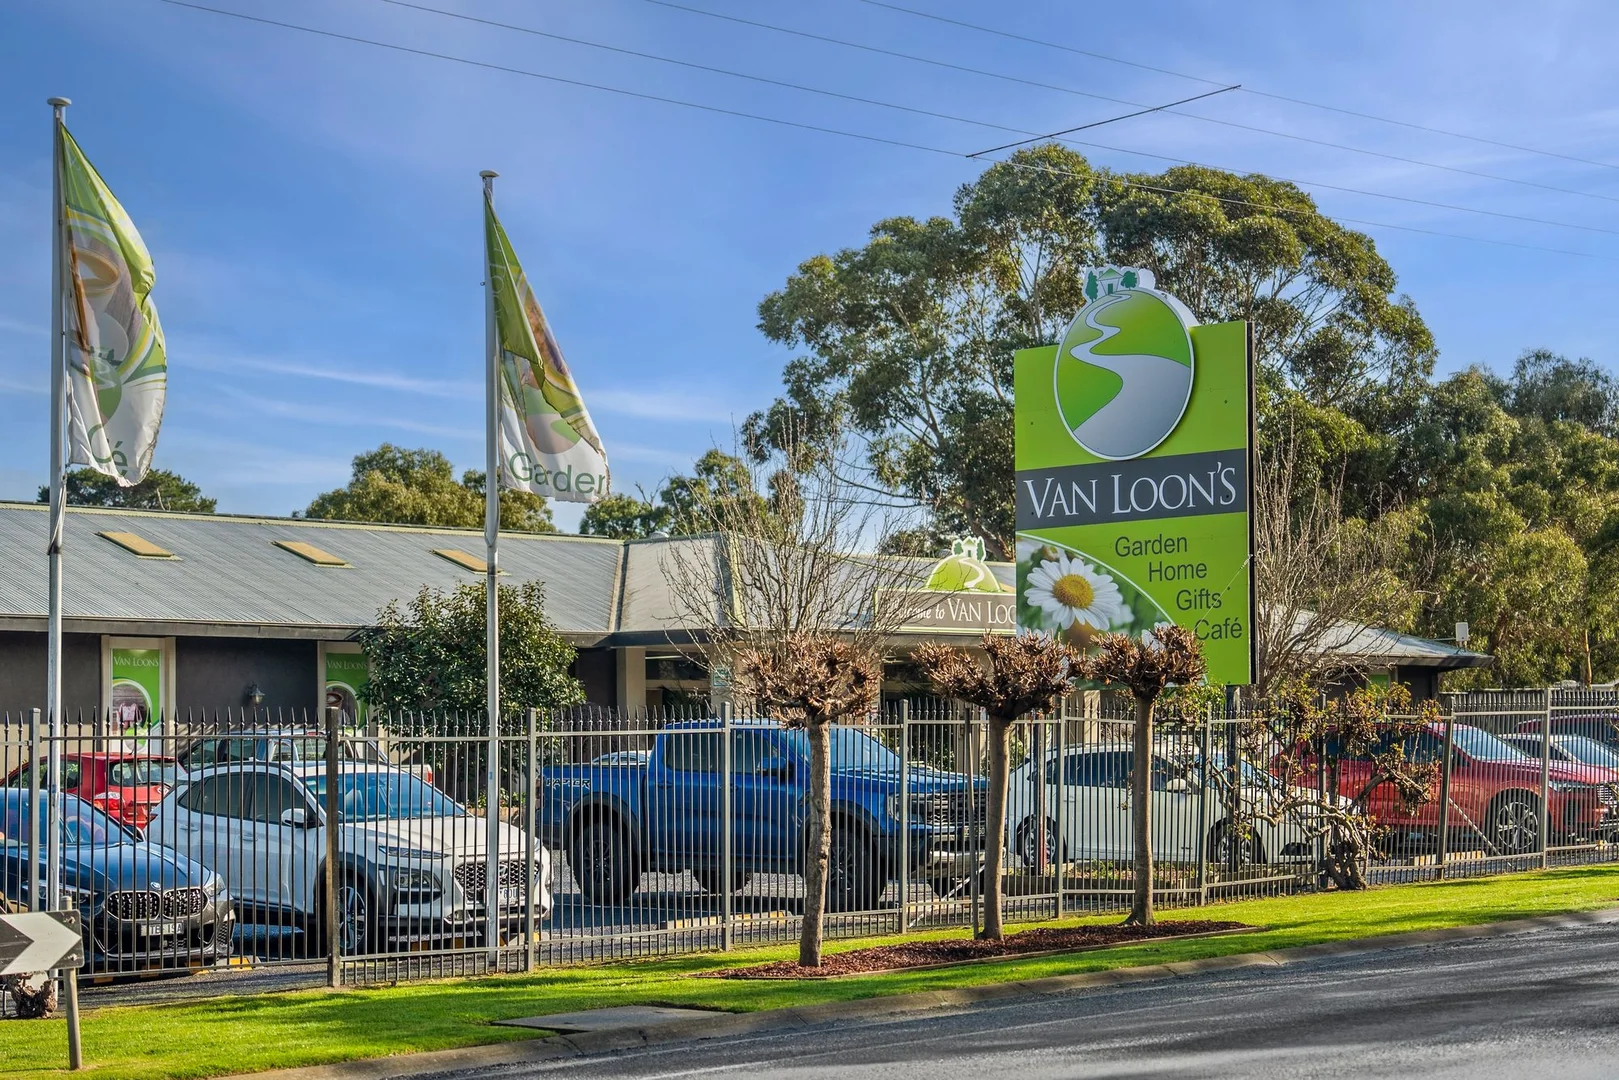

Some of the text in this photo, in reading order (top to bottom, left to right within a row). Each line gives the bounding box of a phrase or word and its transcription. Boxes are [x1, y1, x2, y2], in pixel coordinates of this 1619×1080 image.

[1023, 461, 1237, 519] VAN LOON'S
[1114, 533, 1188, 557] Garden
[1148, 561, 1208, 583] Home
[935, 603, 945, 620] to
[947, 598, 982, 622] VAN
[1176, 587, 1223, 611] Gifts
[1194, 616, 1243, 641] Café
[113, 656, 131, 666] VAN
[326, 659, 342, 669] VAN
